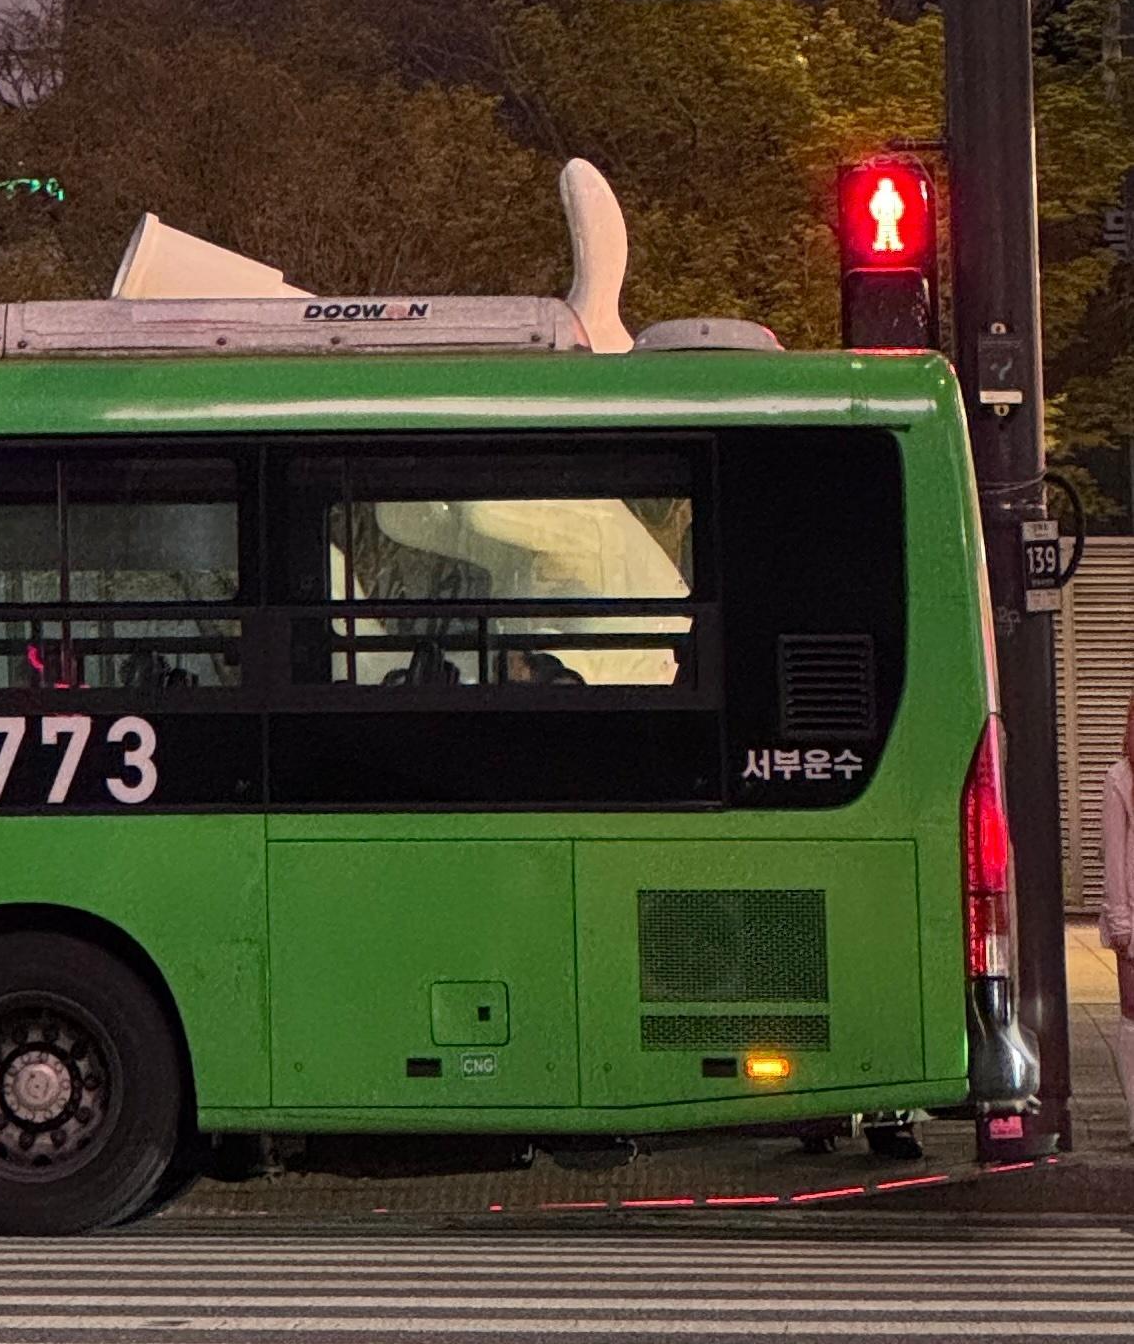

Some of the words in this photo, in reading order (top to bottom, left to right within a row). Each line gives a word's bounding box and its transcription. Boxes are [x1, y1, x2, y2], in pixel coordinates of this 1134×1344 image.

[1027, 546, 1057, 573] 139
[742, 749, 863, 780] 서부운수
[463, 1057, 494, 1074] CNG
